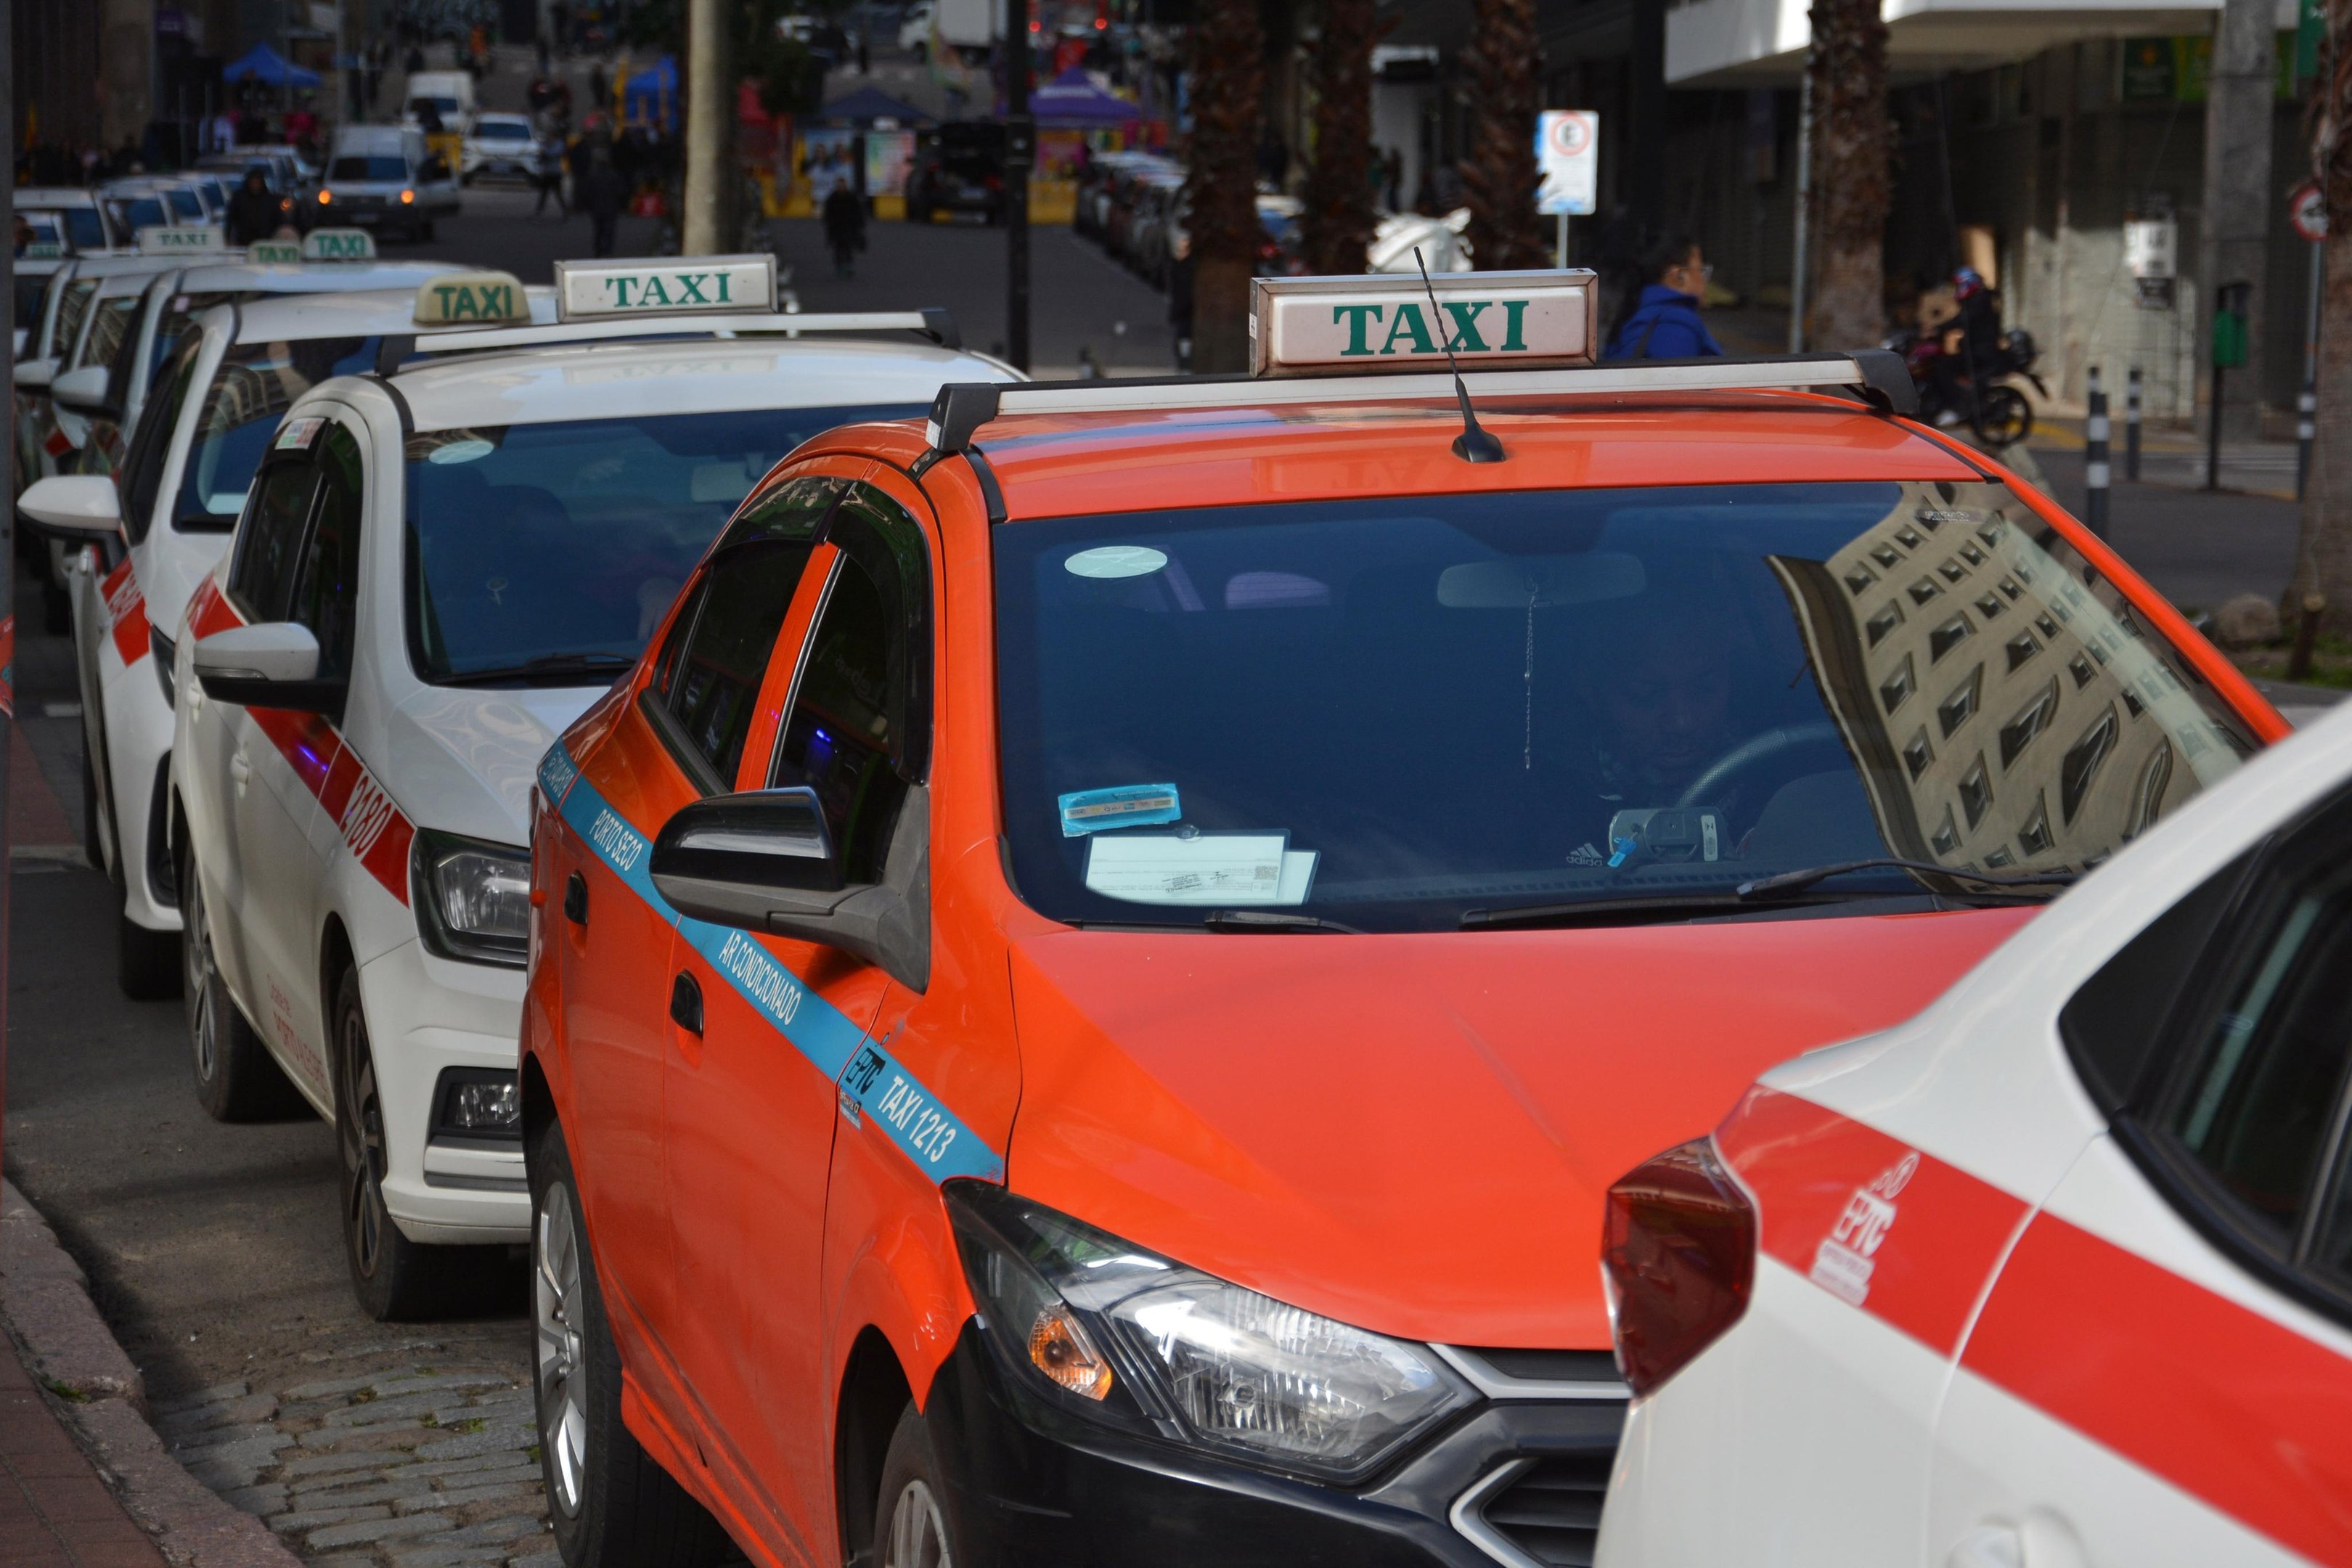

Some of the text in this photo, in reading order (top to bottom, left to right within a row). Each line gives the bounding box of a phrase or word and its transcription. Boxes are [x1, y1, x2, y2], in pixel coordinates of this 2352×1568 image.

[1561, 123, 1578, 148] E
[157, 233, 208, 246] TAXI
[256, 245, 300, 263] TAXI
[314, 234, 367, 258] TAXI
[432, 285, 513, 319] TAXI
[605, 273, 732, 308] TAXI
[1333, 300, 1530, 356] TAXI
[339, 775, 392, 857] 2180
[589, 809, 643, 872] PORTO SECO
[1567, 855, 1603, 867] adida
[719, 930, 802, 1026] AR CONDICIONADO
[878, 1075, 957, 1163] TAXI 1213
